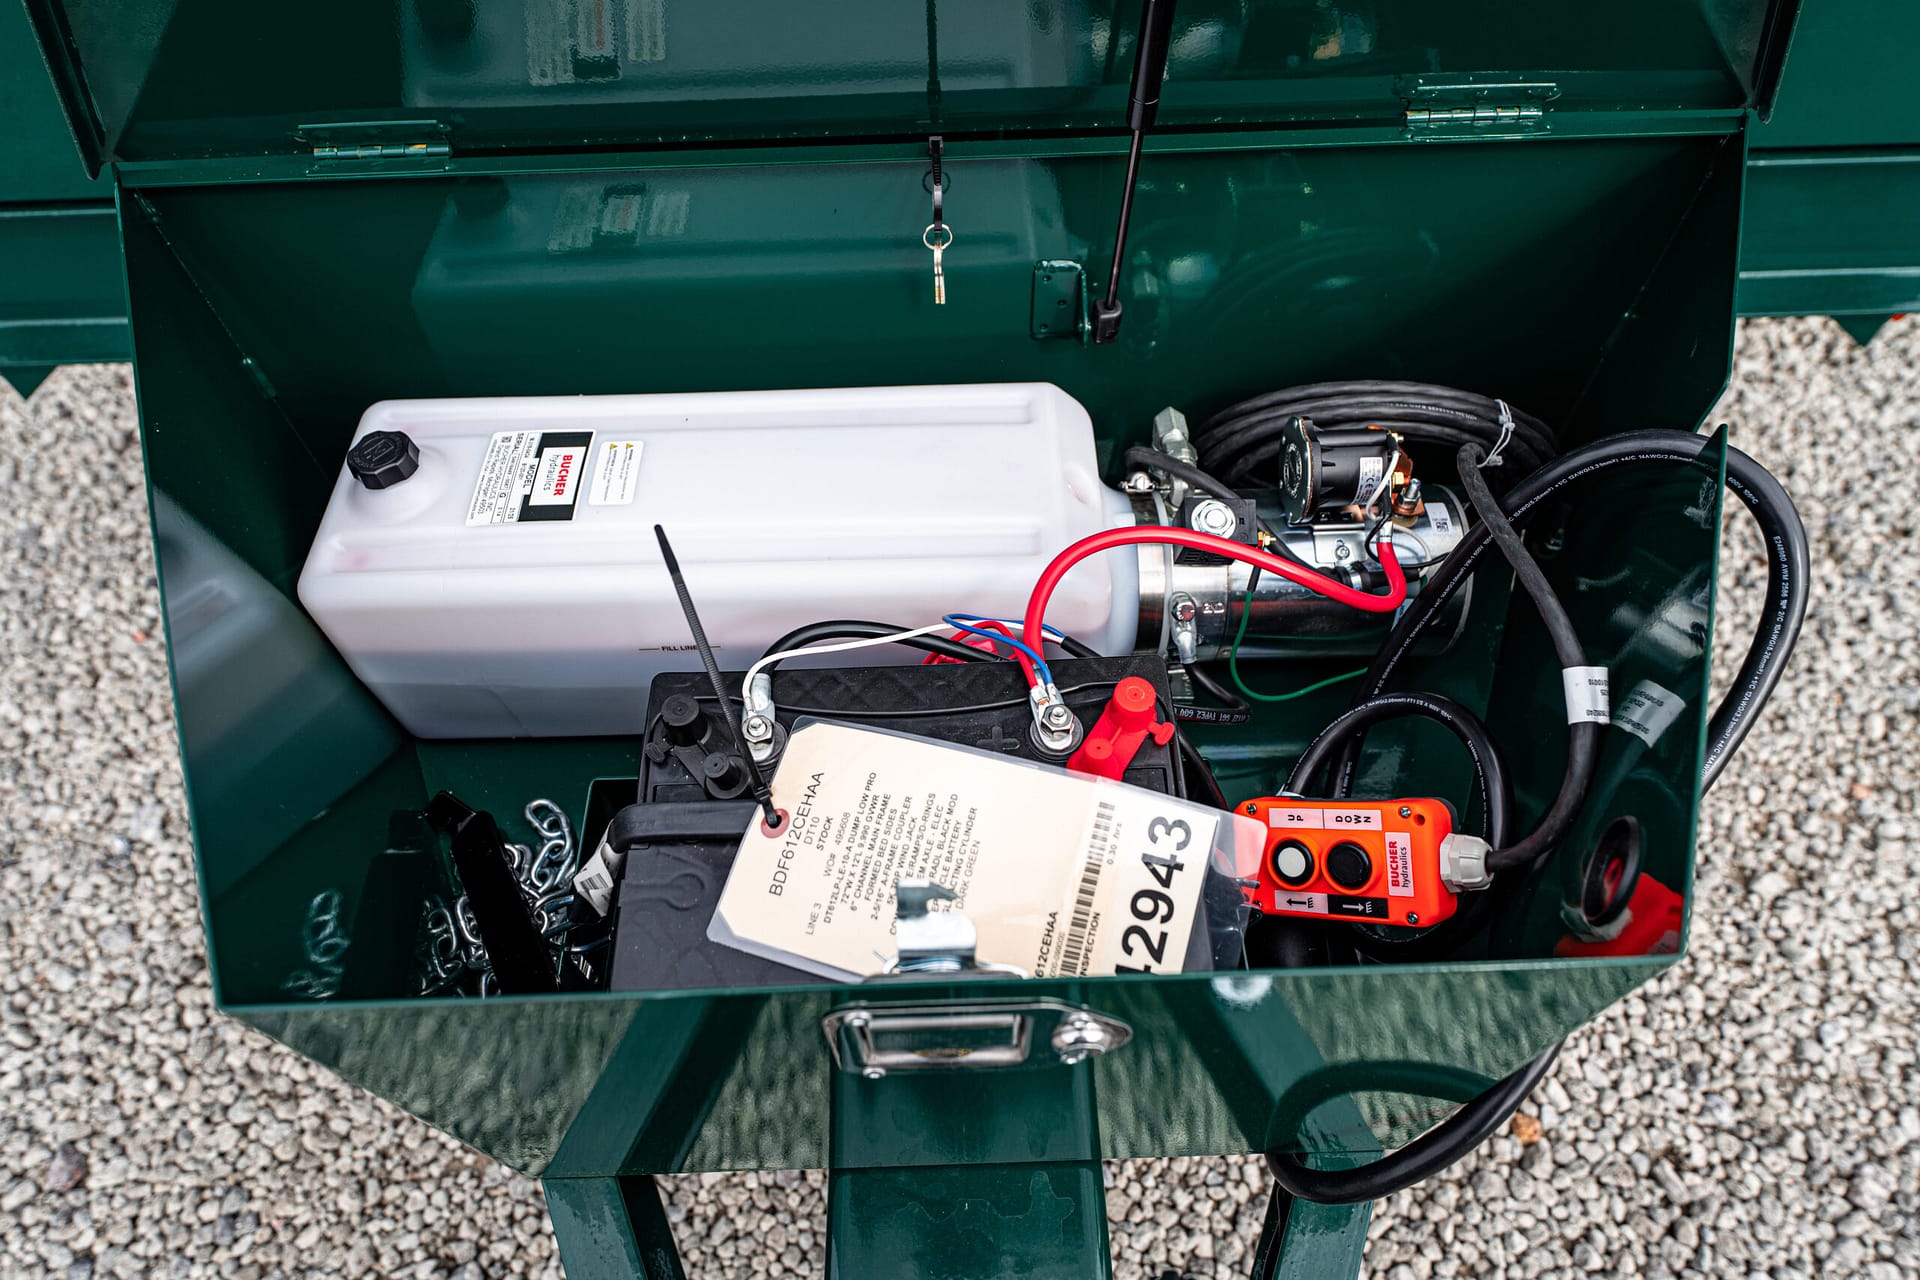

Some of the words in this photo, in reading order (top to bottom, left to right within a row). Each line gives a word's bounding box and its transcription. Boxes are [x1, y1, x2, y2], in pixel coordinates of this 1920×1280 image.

[511, 432, 525, 453] SERIAL
[524, 464, 536, 488] MODEL
[543, 454, 561, 491] hydraulics
[553, 454, 573, 496] BUCHER
[1781, 563, 1790, 581] AWM
[768, 772, 824, 896] BDF612CEHAA
[803, 816, 820, 845] DT10
[816, 816, 833, 851] STOCK
[857, 825, 870, 848] 9,990
[865, 795, 880, 822] GVWR
[906, 816, 917, 841] JACK
[922, 839, 934, 864] AXLE
[930, 805, 944, 830] ELEC
[928, 854, 942, 878] RADL
[936, 818, 951, 850] BLACK
[946, 794, 958, 815] MOD
[958, 807, 977, 855] CYLINDER
[1286, 814, 1304, 822] UP
[1335, 815, 1372, 824] DOWN
[823, 845, 853, 924] DT612LP-LE-10-A
[848, 816, 860, 843] DUMP
[857, 793, 869, 815] LOW
[864, 772, 876, 791] PRO
[853, 855, 873, 899] CHANNEL
[867, 827, 880, 851] MAIN
[875, 794, 891, 825] FRAME
[864, 860, 882, 901] FORMED
[877, 838, 888, 858] BED
[883, 808, 897, 836] SIDES
[880, 844, 898, 886] A-FRAME
[893, 796, 912, 841] COUPLER
[897, 844, 909, 868] WIND
[944, 820, 961, 863] BATTERY
[805, 912, 819, 935] LINE
[824, 853, 836, 876] WO#
[835, 812, 851, 846] 495608
[890, 870, 901, 888] TOP
[954, 878, 970, 909] DARK
[964, 840, 980, 877] GREEN
[1391, 840, 1399, 887] BUCHER
[1401, 846, 1411, 888] hydraulics
[886, 893, 897, 905] 5K
[1081, 912, 1101, 977] NSPECTION
